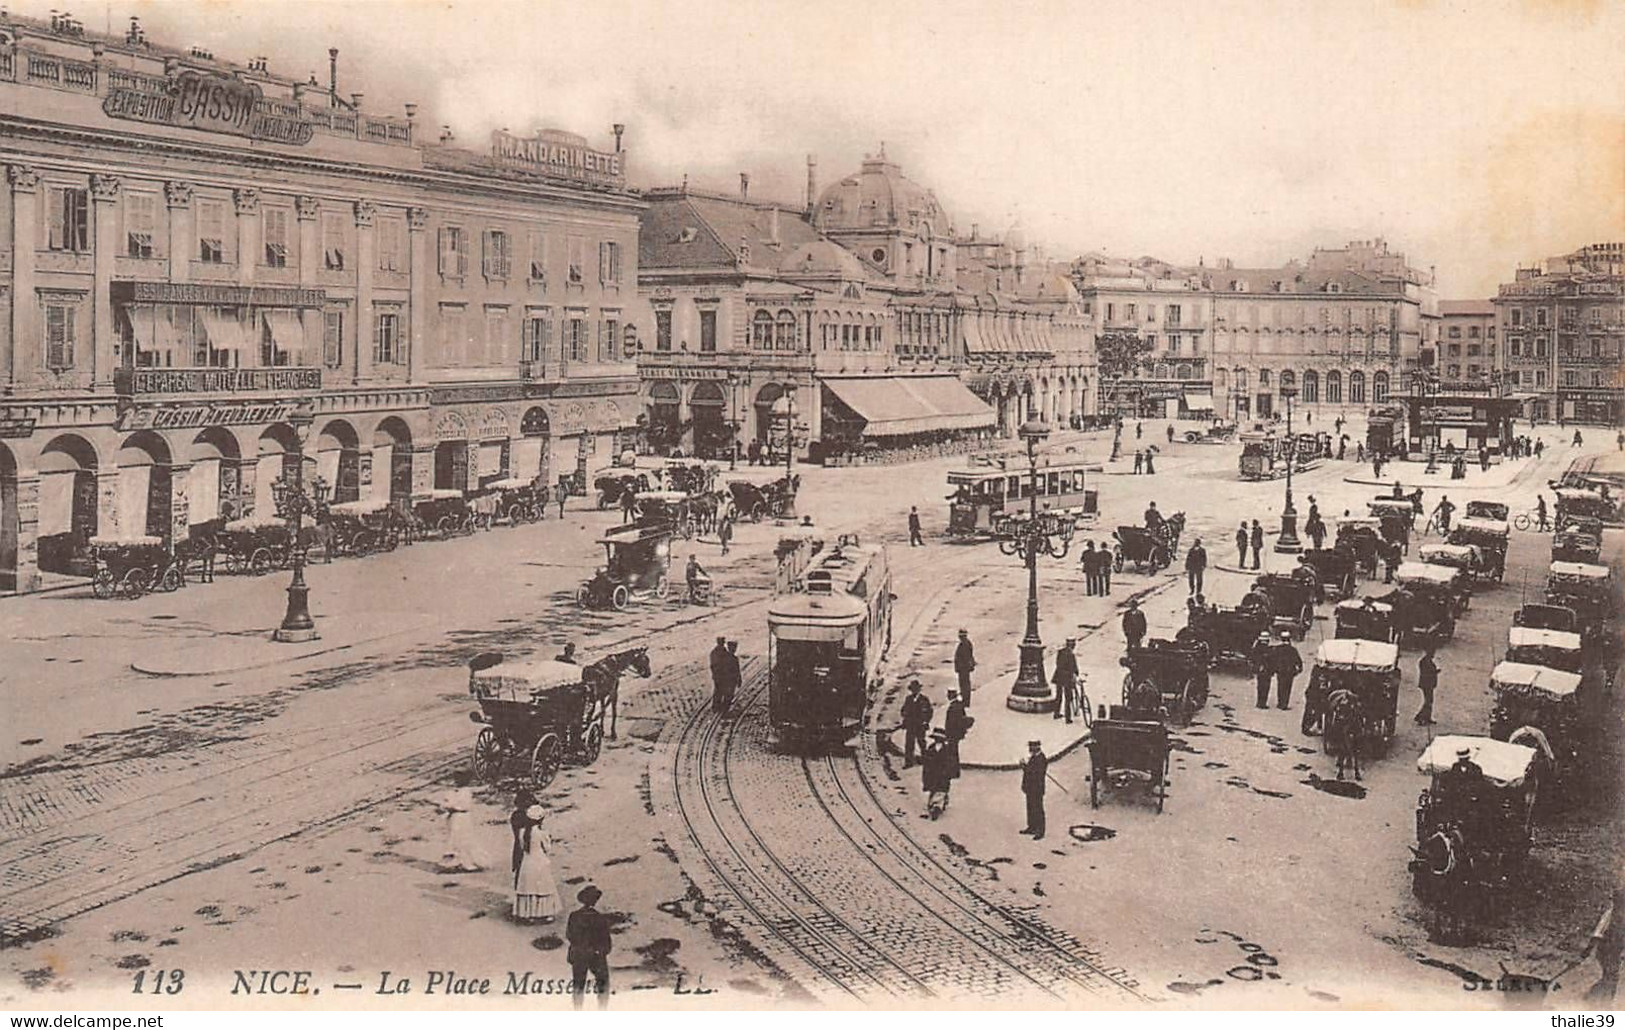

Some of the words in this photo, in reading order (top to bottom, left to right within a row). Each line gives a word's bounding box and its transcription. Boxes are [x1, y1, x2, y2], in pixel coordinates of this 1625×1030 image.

[111, 90, 176, 121] EXPOSITION
[181, 75, 255, 128] CASSIN
[500, 136, 620, 176] MANDARINETTE
[153, 408, 203, 427] CASSIN
